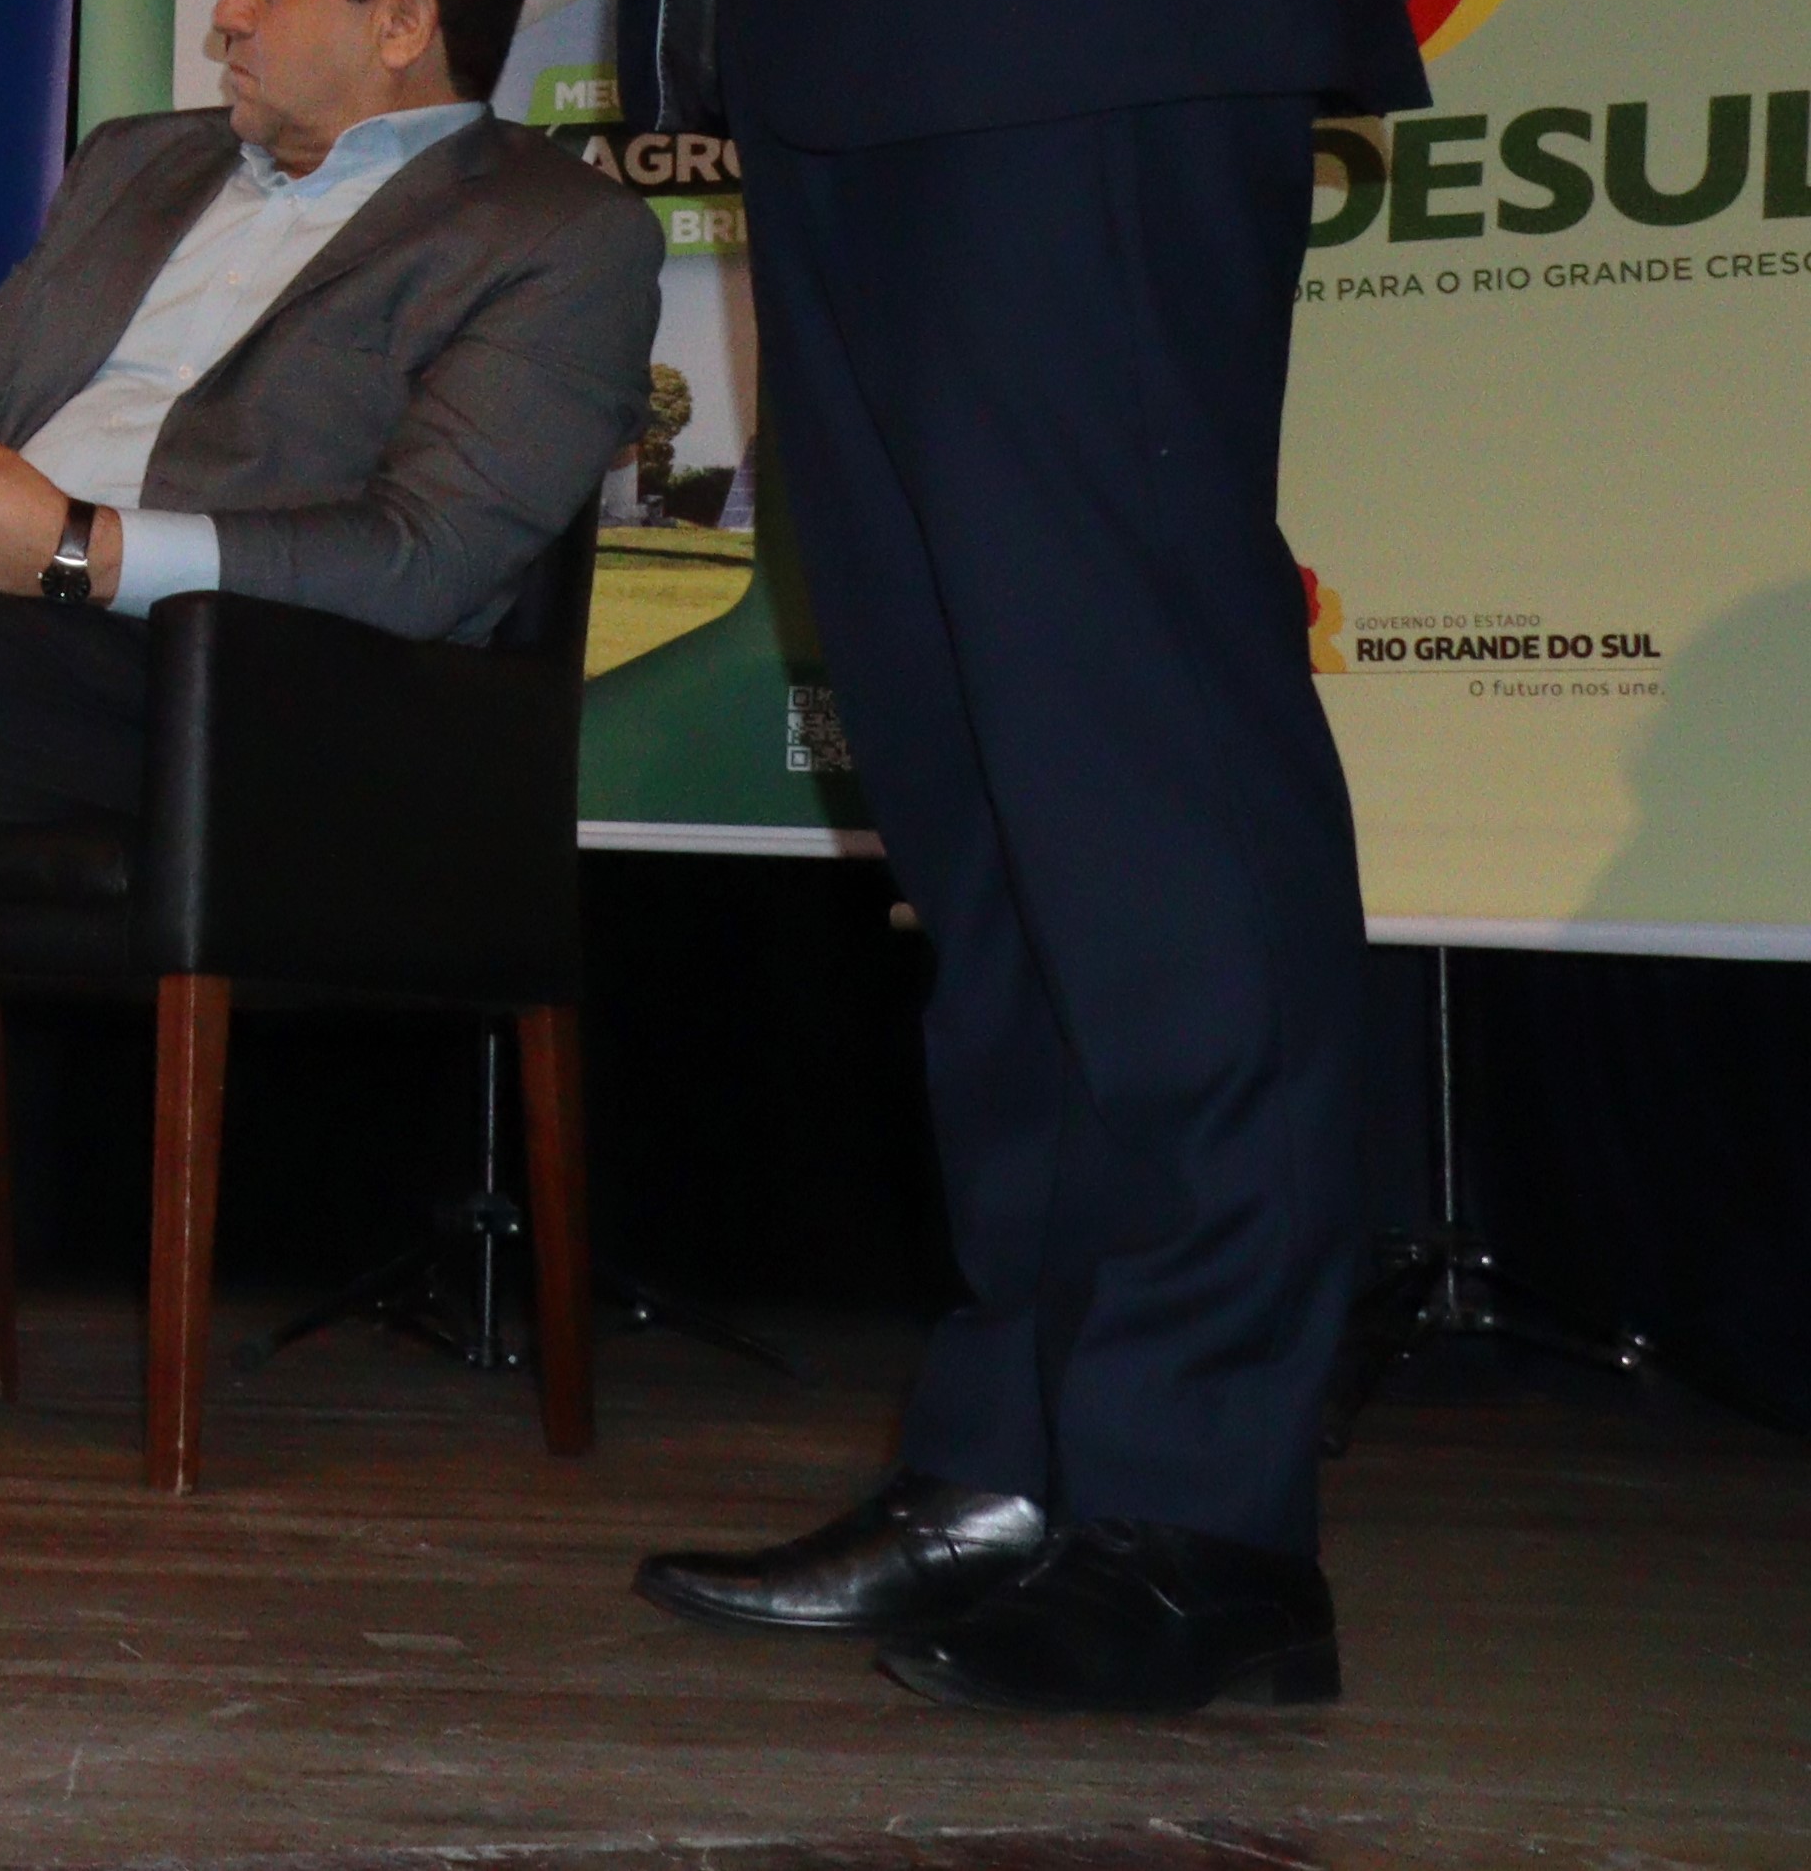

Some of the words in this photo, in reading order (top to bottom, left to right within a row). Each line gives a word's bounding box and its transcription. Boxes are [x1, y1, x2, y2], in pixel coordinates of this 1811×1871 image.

[1338, 273, 1424, 300] PARA
[1436, 271, 1461, 294] O
[1474, 267, 1530, 291] RIO
[1544, 257, 1692, 286] GRANDE
[1355, 616, 1436, 630] GOVERNO
[1443, 615, 1467, 628] DO
[1474, 614, 1540, 628] ESTADO
[1357, 638, 1406, 661] RIO
[1415, 636, 1539, 661] GRANDE
[1548, 635, 1593, 659] DO
[1601, 633, 1661, 659] SUL
[1469, 680, 1484, 696] O
[1493, 680, 1563, 697] futuro
[1571, 683, 1609, 696] nos
[1618, 682, 1665, 696] une.
